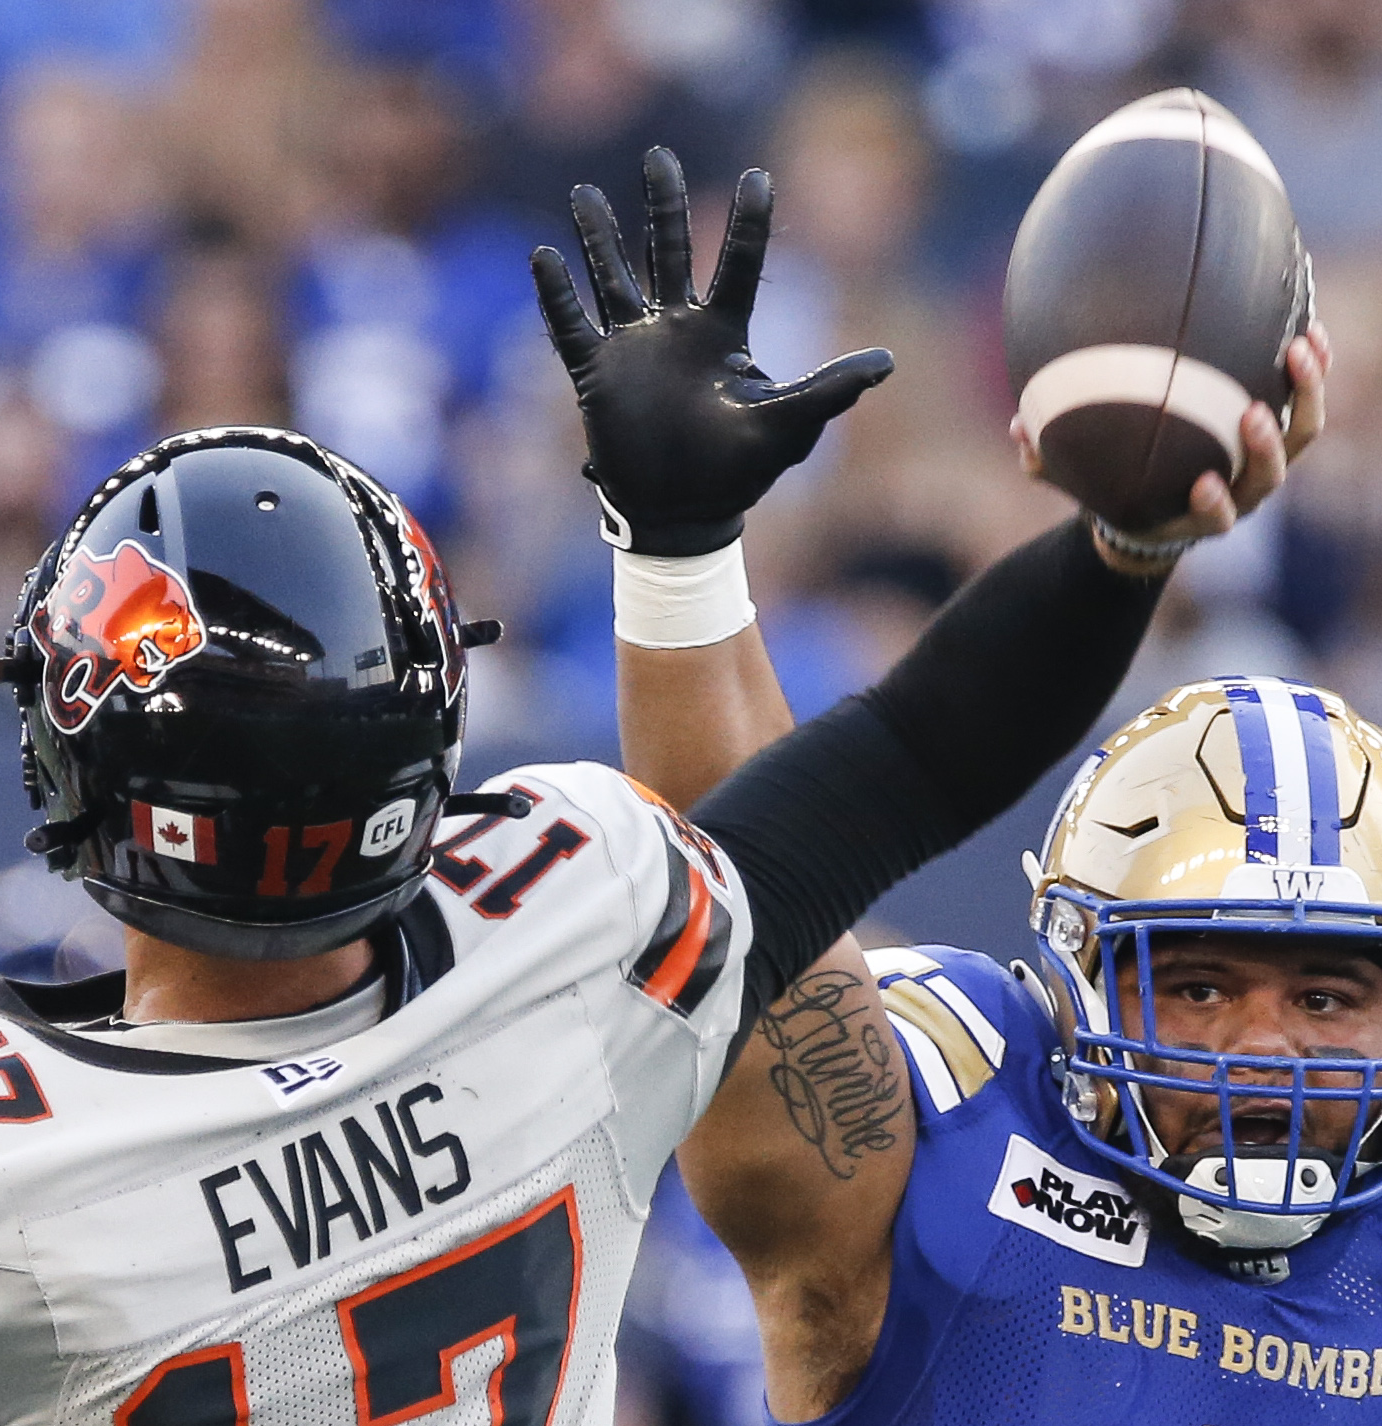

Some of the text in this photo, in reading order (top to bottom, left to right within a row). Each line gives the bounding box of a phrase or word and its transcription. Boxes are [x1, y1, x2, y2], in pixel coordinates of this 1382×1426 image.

[370, 813, 406, 846] CFL
[256, 819, 354, 897] 17
[1274, 870, 1324, 900] W
[199, 1083, 472, 1294] EVANS
[1041, 1167, 1135, 1219] PLAY
[1034, 1190, 1140, 1246] NOW
[1059, 1286, 1200, 1360] BLUE
